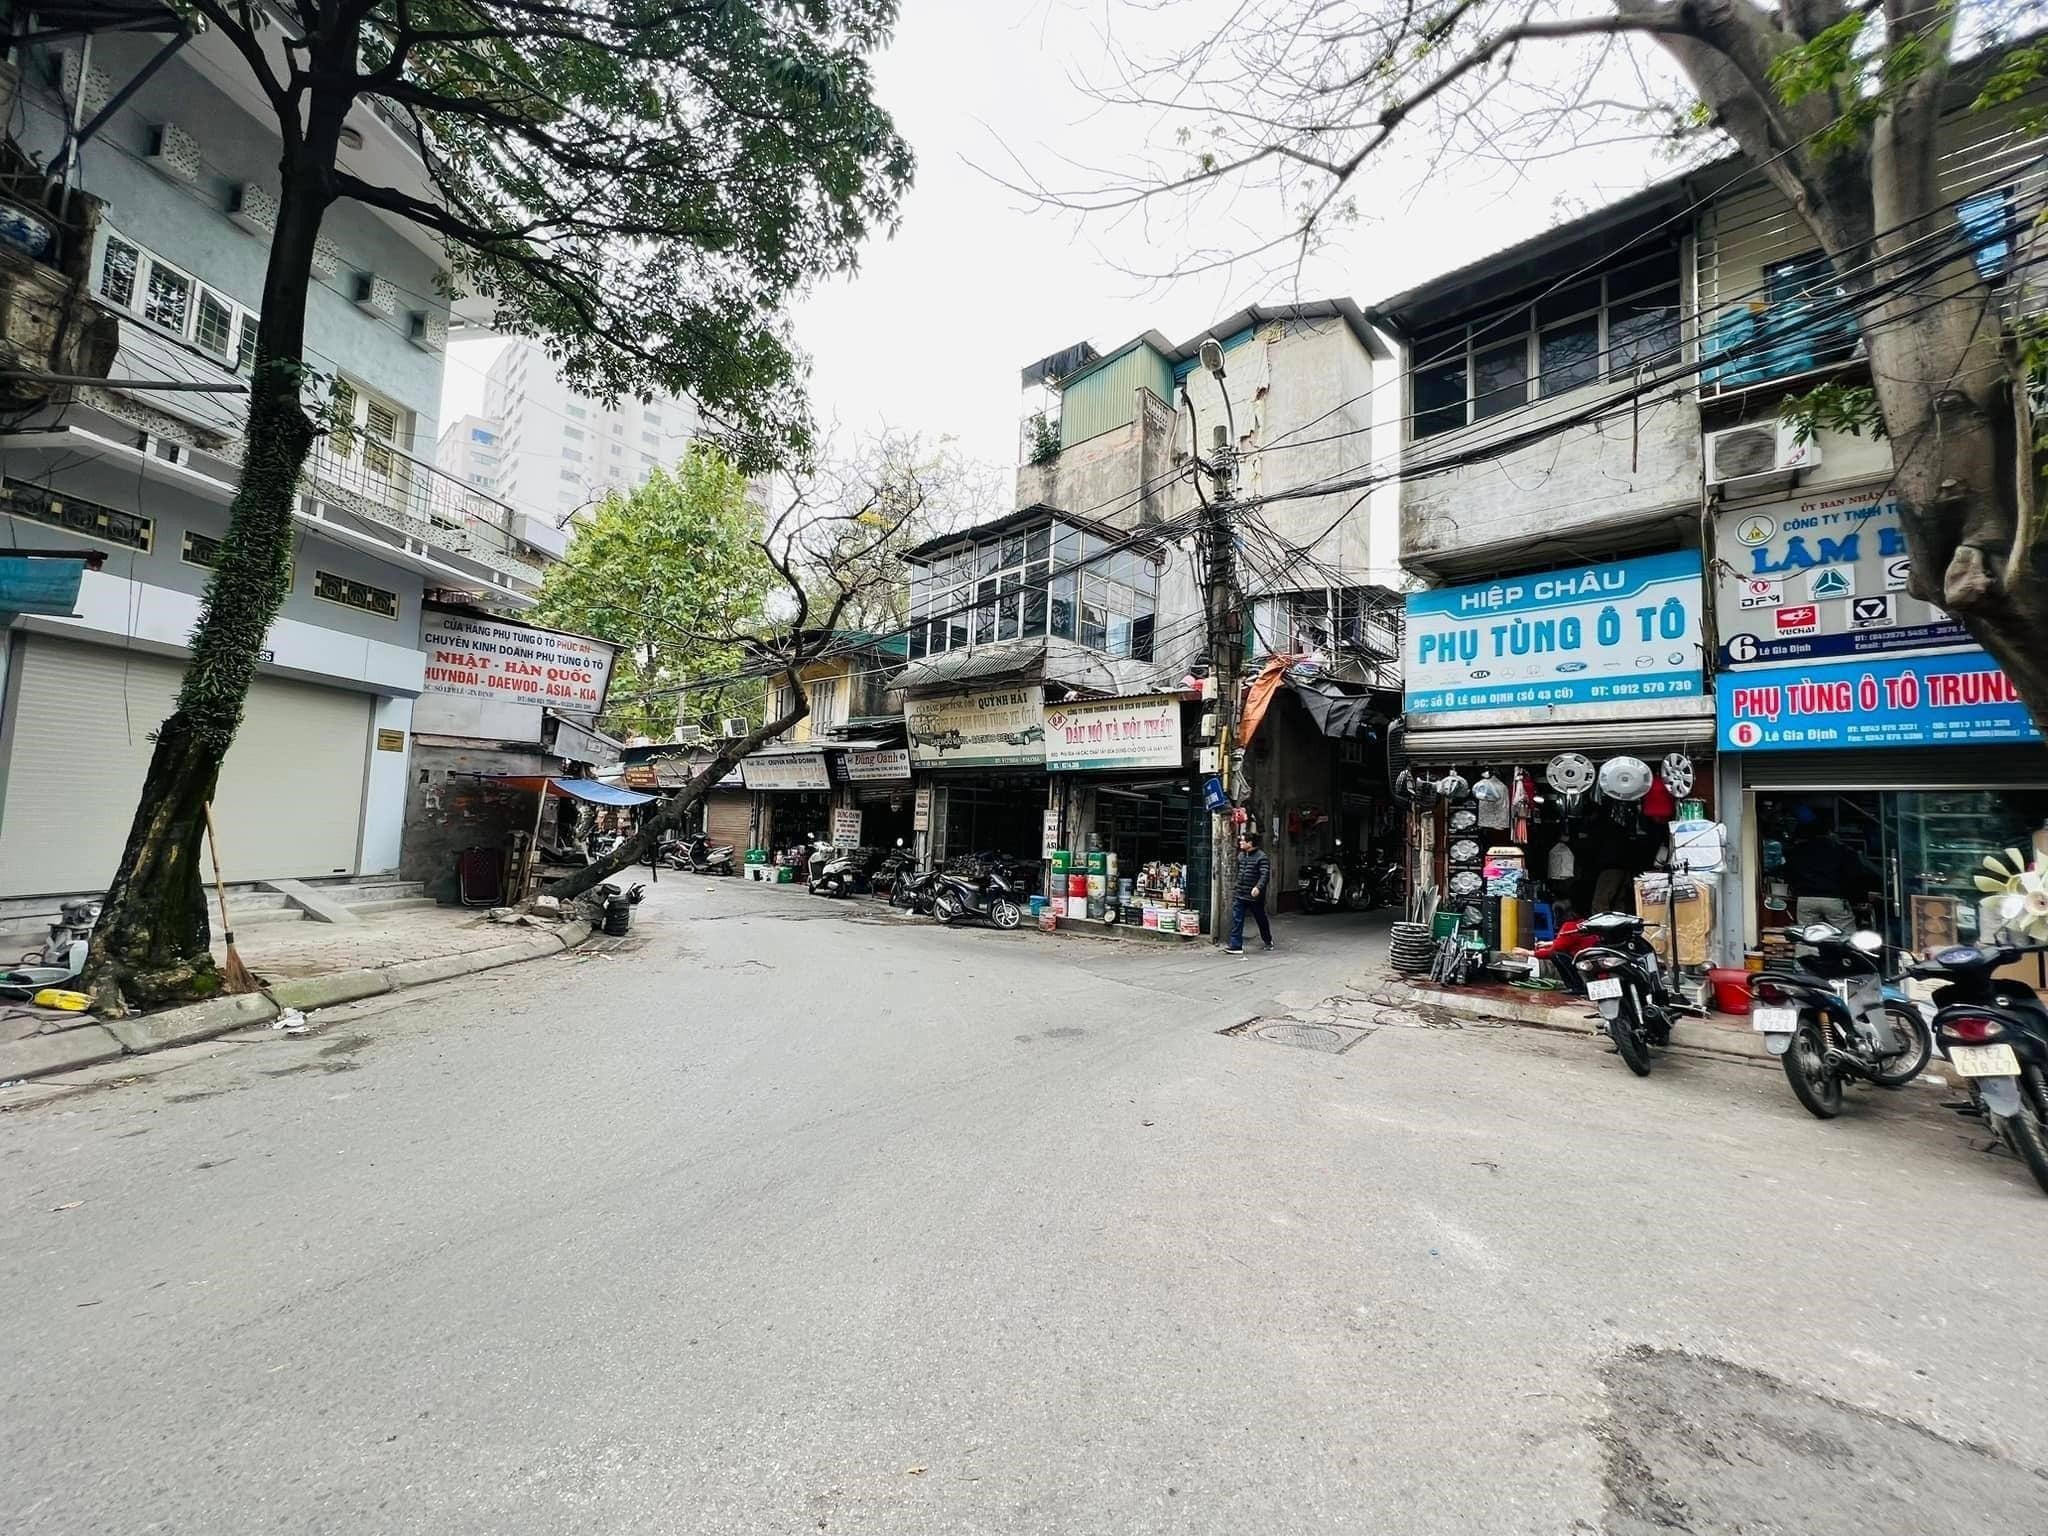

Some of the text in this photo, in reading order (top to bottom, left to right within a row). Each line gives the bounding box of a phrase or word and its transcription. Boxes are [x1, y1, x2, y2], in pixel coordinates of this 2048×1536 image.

[1783, 516, 1818, 532] CÔNG
[1822, 513, 1840, 525] TY
[1844, 506, 1881, 521] TNHH
[1751, 533, 1860, 575] LÂM
[1461, 570, 1625, 611] HIỆP CHÂU
[466, 622, 491, 637] HÀNG
[492, 628, 511, 642] PHỤ
[513, 632, 535, 645] TÙNG
[1419, 597, 1685, 666] PHỤ TÙNG Ô TÔ
[425, 633, 470, 649] CHUYÊN
[472, 640, 497, 653] KINH
[499, 645, 534, 660] DOANH
[536, 650, 555, 664] PHỤ
[557, 653, 581, 667] TÙNG
[592, 659, 603, 670] TÔ
[1729, 635, 1757, 661] 6
[1772, 646, 1788, 655] Gia
[1790, 643, 1811, 655] Định
[436, 650, 491, 670] NHẬT
[505, 660, 542, 677] HÀN
[547, 667, 592, 684] QUỐC
[487, 675, 538, 693] DAEWOO
[545, 684, 571, 697] ASIA
[579, 687, 597, 701] KIA
[978, 692, 1009, 709] QUỲNH
[1010, 689, 1028, 705] HẢI
[1471, 694, 1487, 705] GIA
[1612, 683, 1639, 695] 0912
[1733, 687, 1780, 722] PHỤ
[1786, 678, 1852, 715] TÙNG
[1859, 673, 1878, 711] Ô
[1883, 670, 1919, 709] TÔ
[1738, 724, 1752, 743] 6
[1765, 730, 1779, 742] Lê
[1783, 729, 1804, 741] Gia
[1808, 728, 1837, 742] Định
